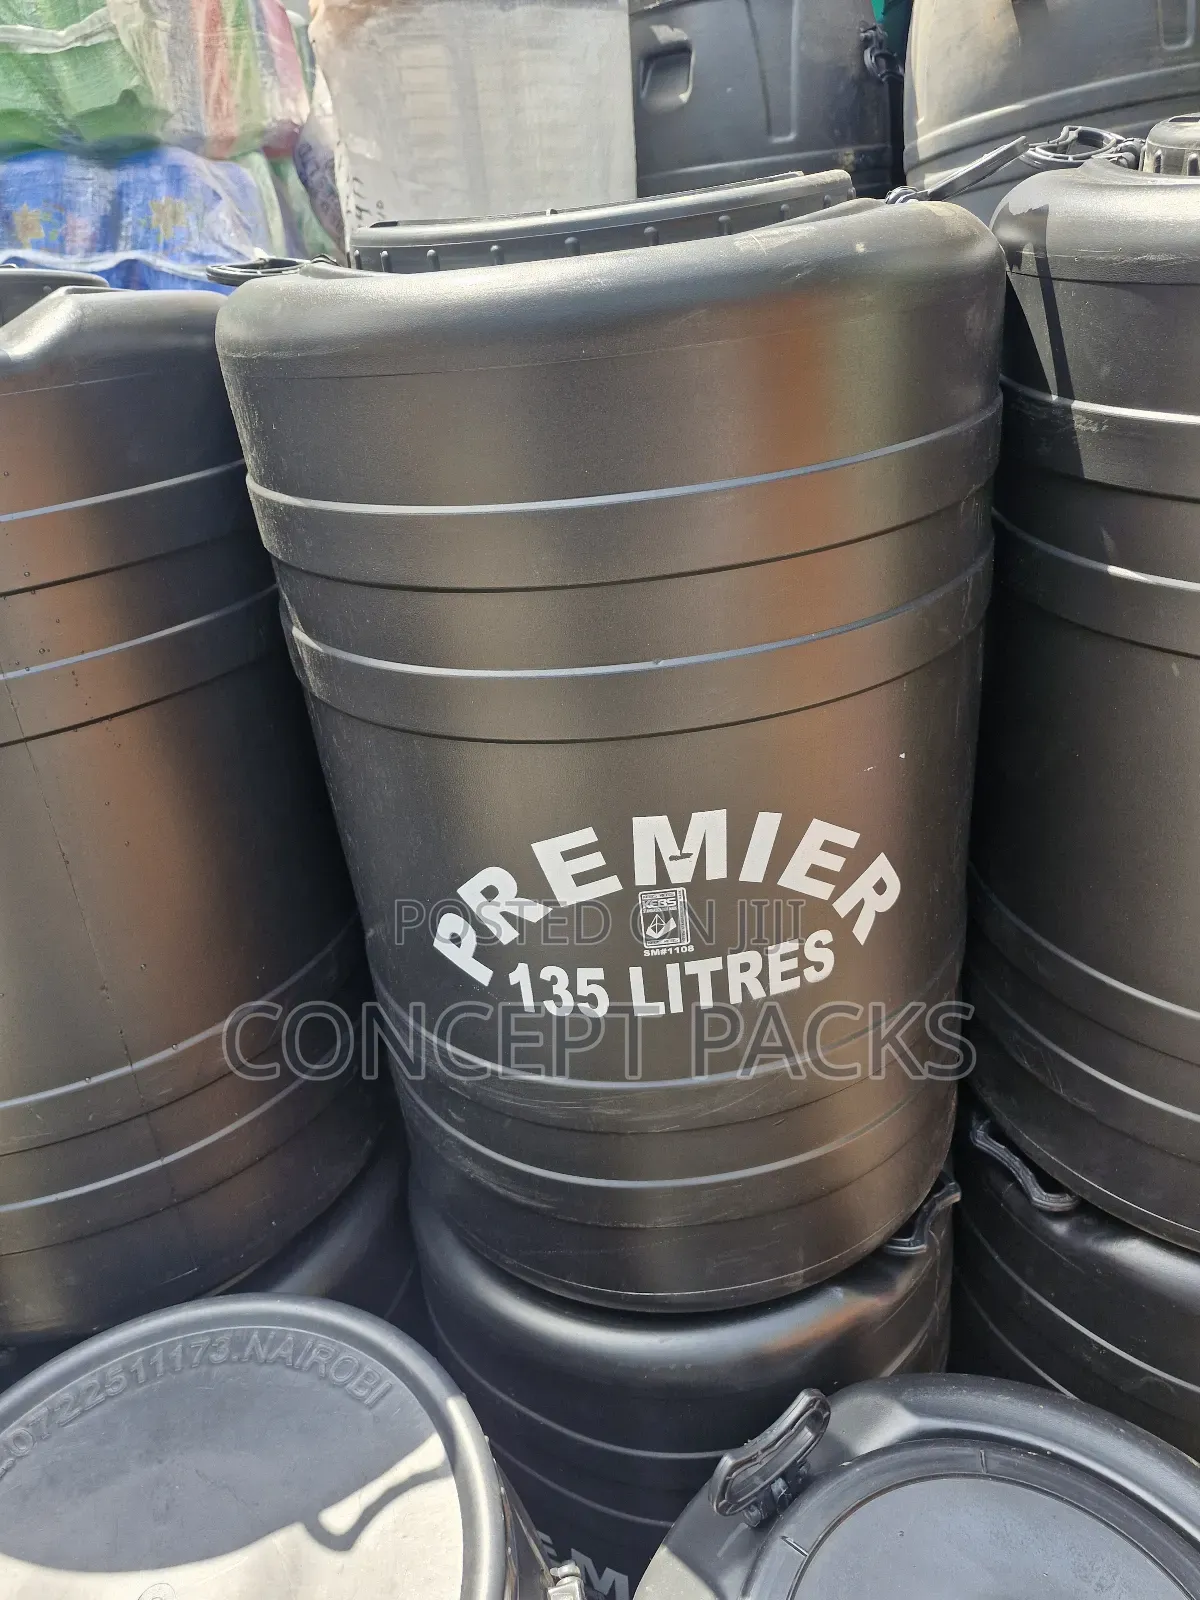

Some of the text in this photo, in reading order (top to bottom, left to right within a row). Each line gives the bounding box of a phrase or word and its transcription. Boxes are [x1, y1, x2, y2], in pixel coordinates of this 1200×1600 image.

[433, 809, 902, 987] PREMIER
[508, 929, 835, 1018] 135 LITRES
[643, 945, 695, 957] SM#1108
